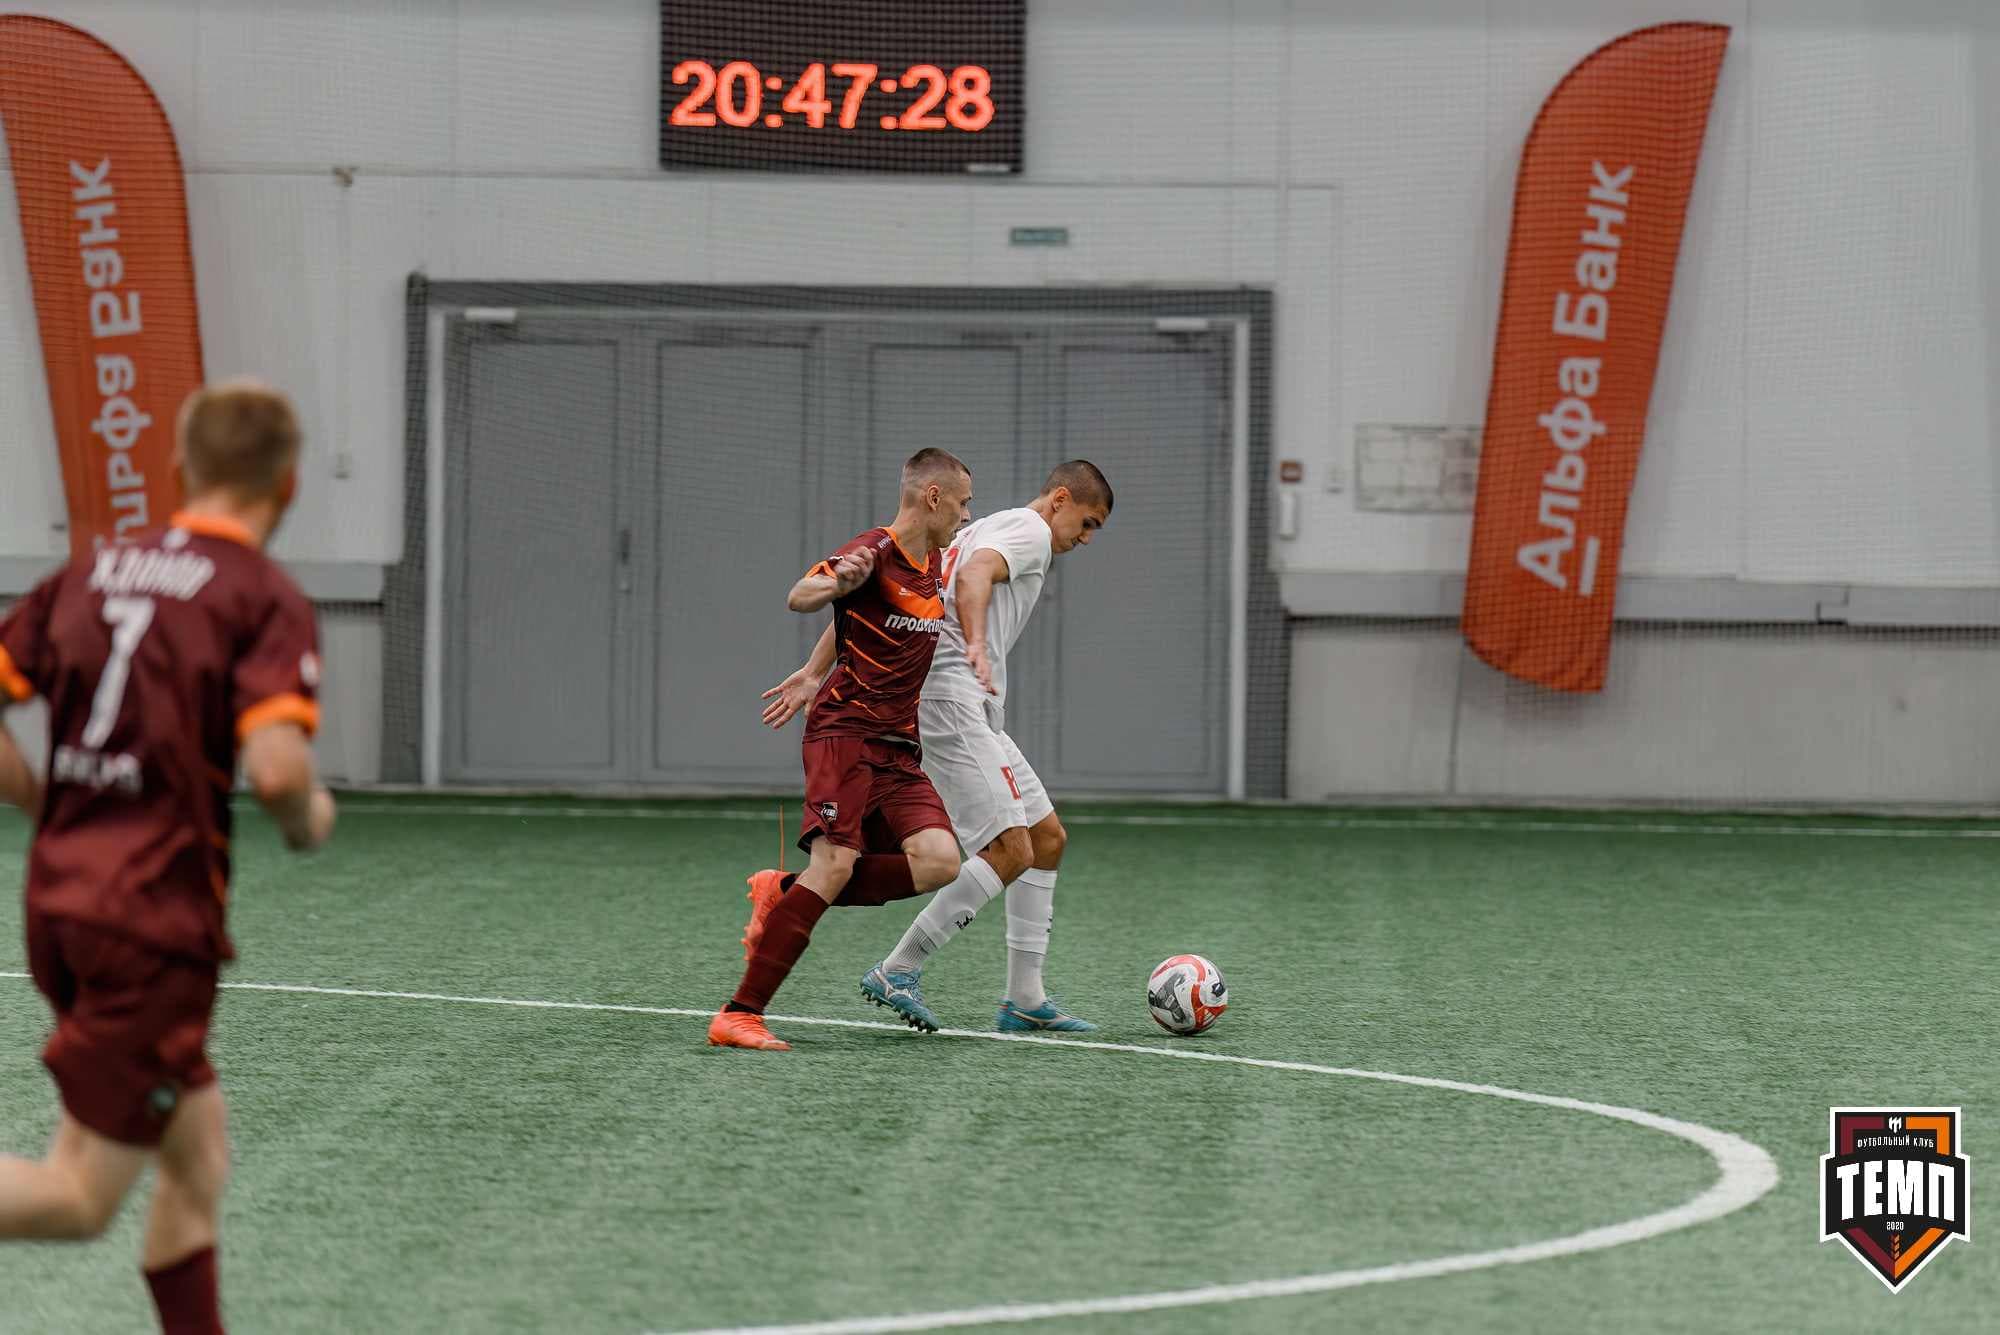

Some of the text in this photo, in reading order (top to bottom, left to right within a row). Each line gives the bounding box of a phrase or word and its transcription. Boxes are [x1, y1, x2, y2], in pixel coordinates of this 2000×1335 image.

[668, 60, 996, 132] 20:47:28
[1516, 160, 1635, 597] Альфа Банк
[82, 596, 156, 748] 7
